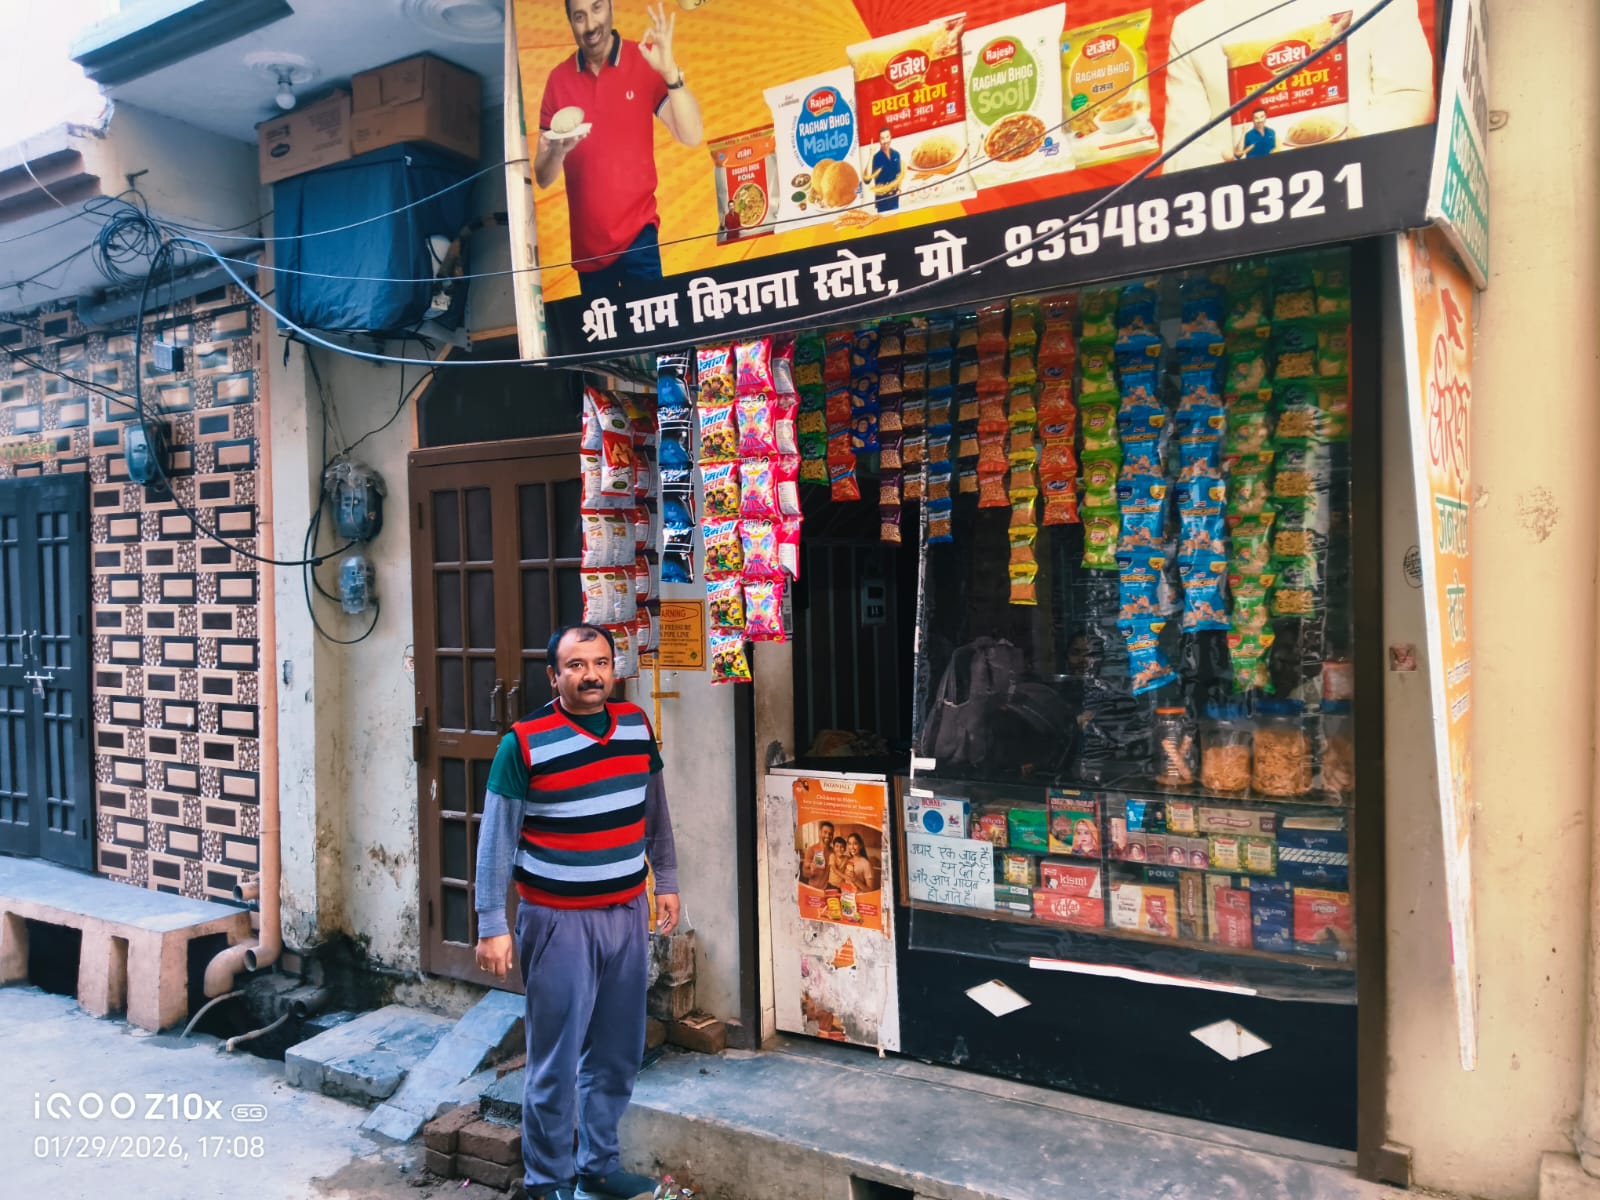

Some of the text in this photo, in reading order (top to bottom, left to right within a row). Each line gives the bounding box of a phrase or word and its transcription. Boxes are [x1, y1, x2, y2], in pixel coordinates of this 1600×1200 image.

[1085, 36, 1117, 57] राजेश
[1266, 44, 1307, 67] राजेश
[889, 54, 926, 80] राजेश
[972, 64, 1034, 91] RAGHAV BHOG
[1075, 61, 1130, 83] RAGHAV BHOG
[1291, 68, 1330, 88] भोग
[809, 94, 834, 109] Rajesh
[871, 92, 911, 117] राघव
[912, 82, 948, 105] भोग
[913, 104, 934, 117] आटा
[799, 112, 850, 136] RAGHAV BHOG
[803, 130, 849, 155] Maida
[581, 297, 618, 343] श्री
[625, 292, 680, 334] राम
[687, 269, 799, 324] किराना
[1003, 162, 1365, 270] 9354830321
